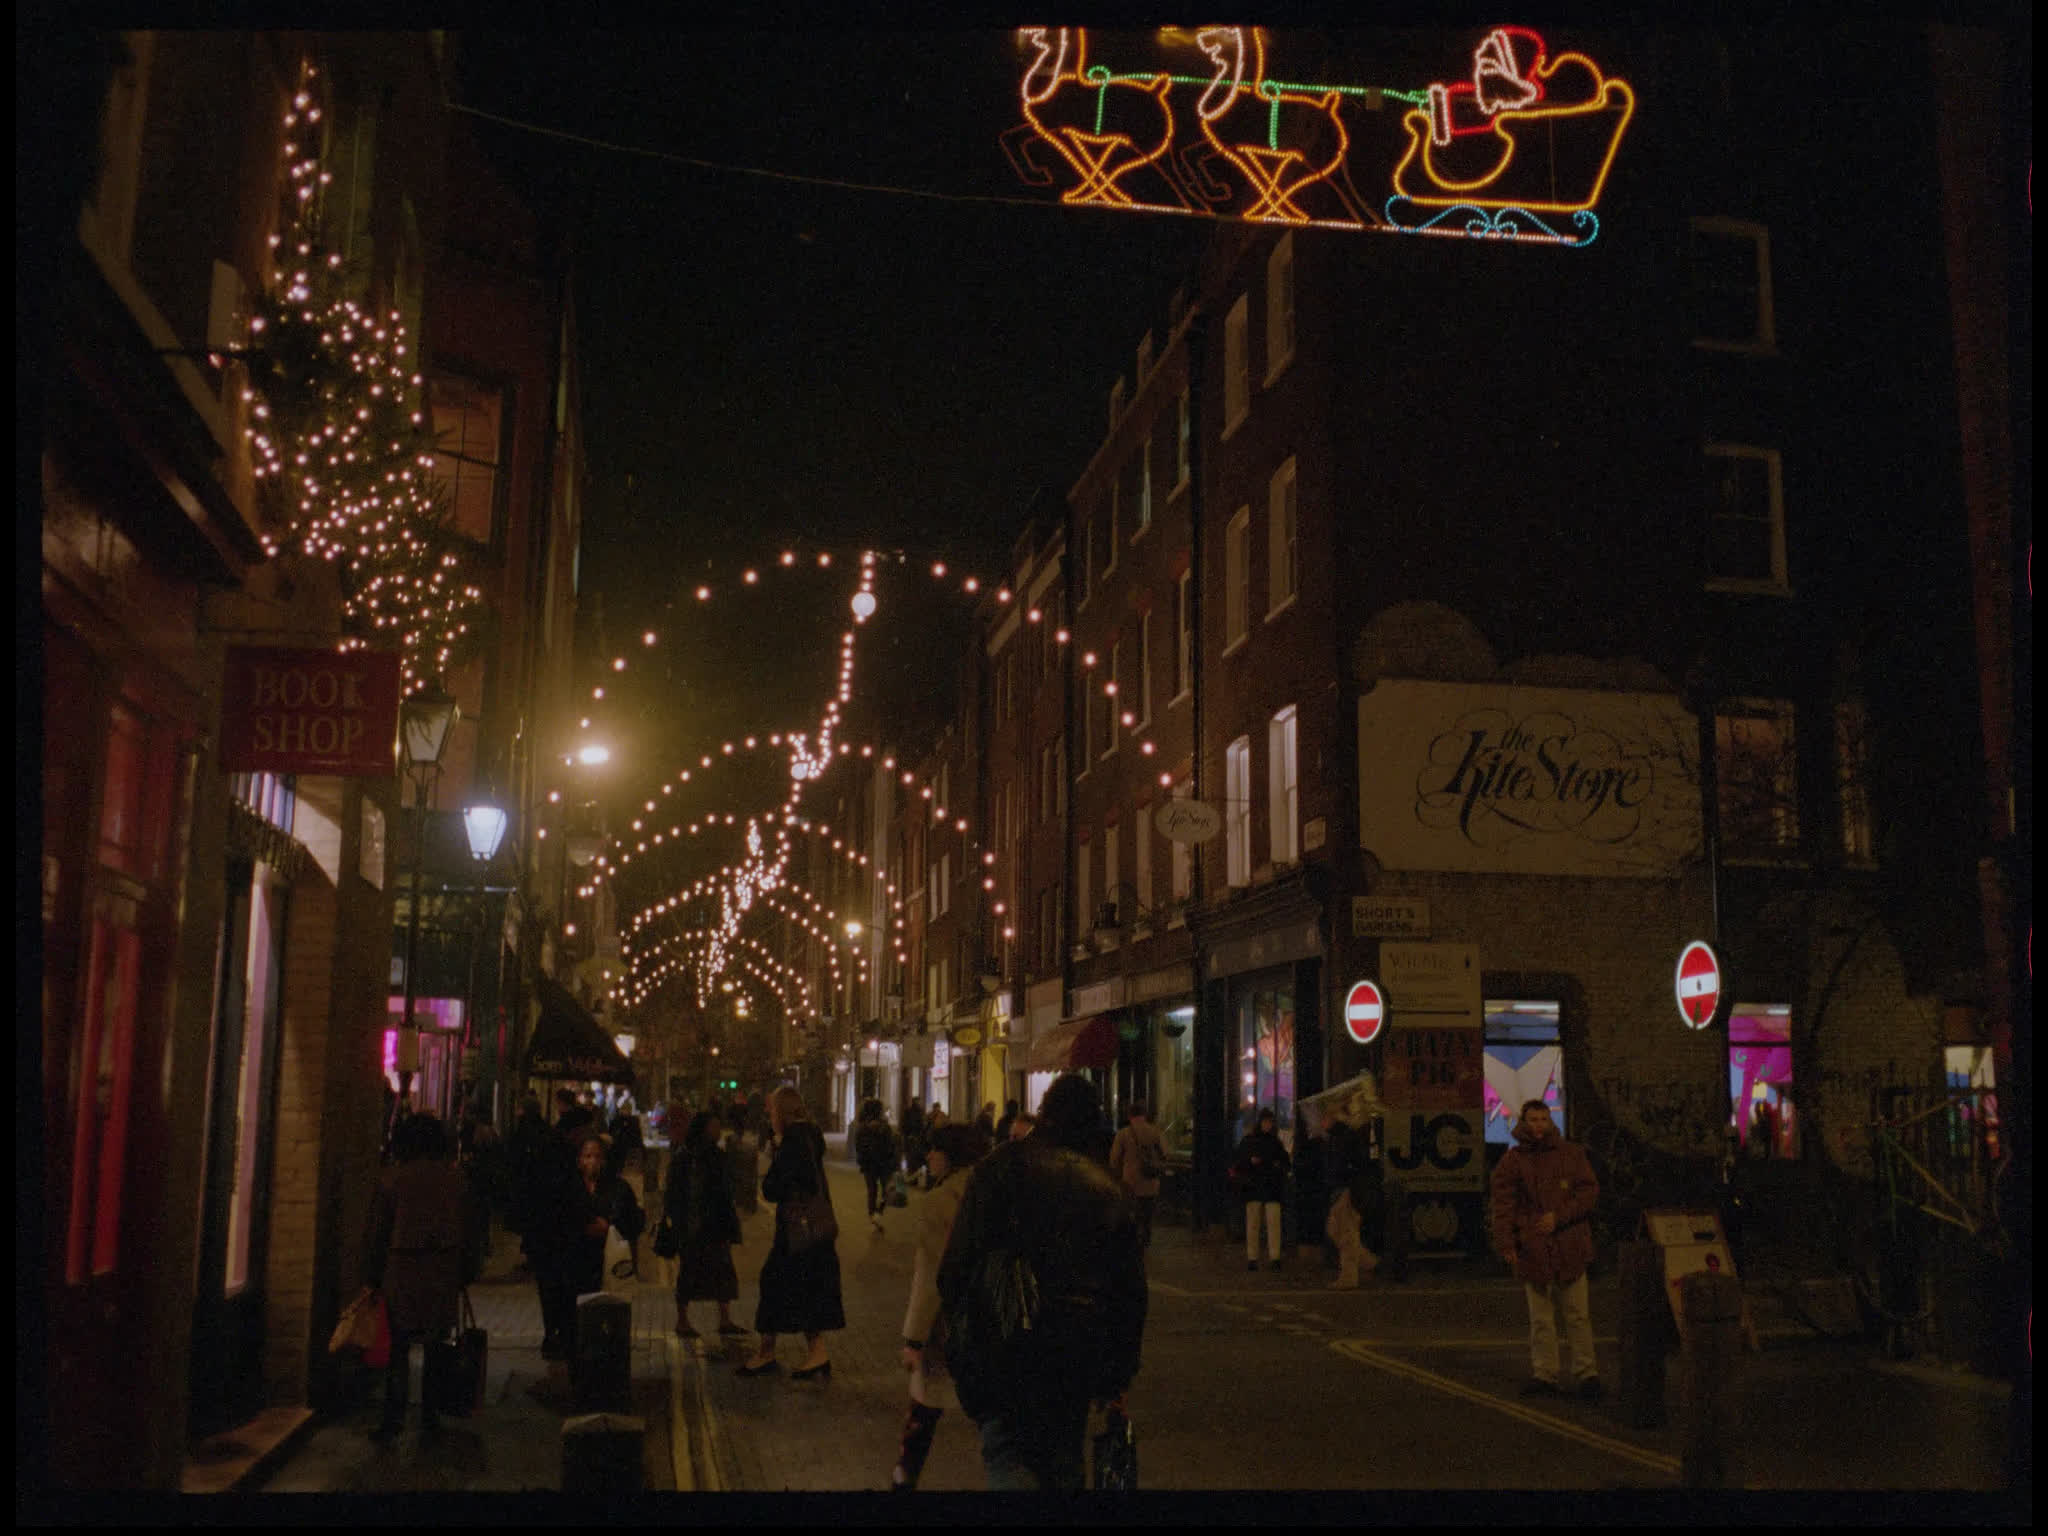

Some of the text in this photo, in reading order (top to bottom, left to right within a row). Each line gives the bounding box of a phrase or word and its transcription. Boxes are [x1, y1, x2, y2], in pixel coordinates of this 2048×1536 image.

[255, 668, 367, 707] BOOK
[254, 715, 363, 753] SHOP
[1500, 727, 1532, 751] the
[1442, 730, 1640, 838] Kite Store
[1387, 1114, 1472, 1170] JC
